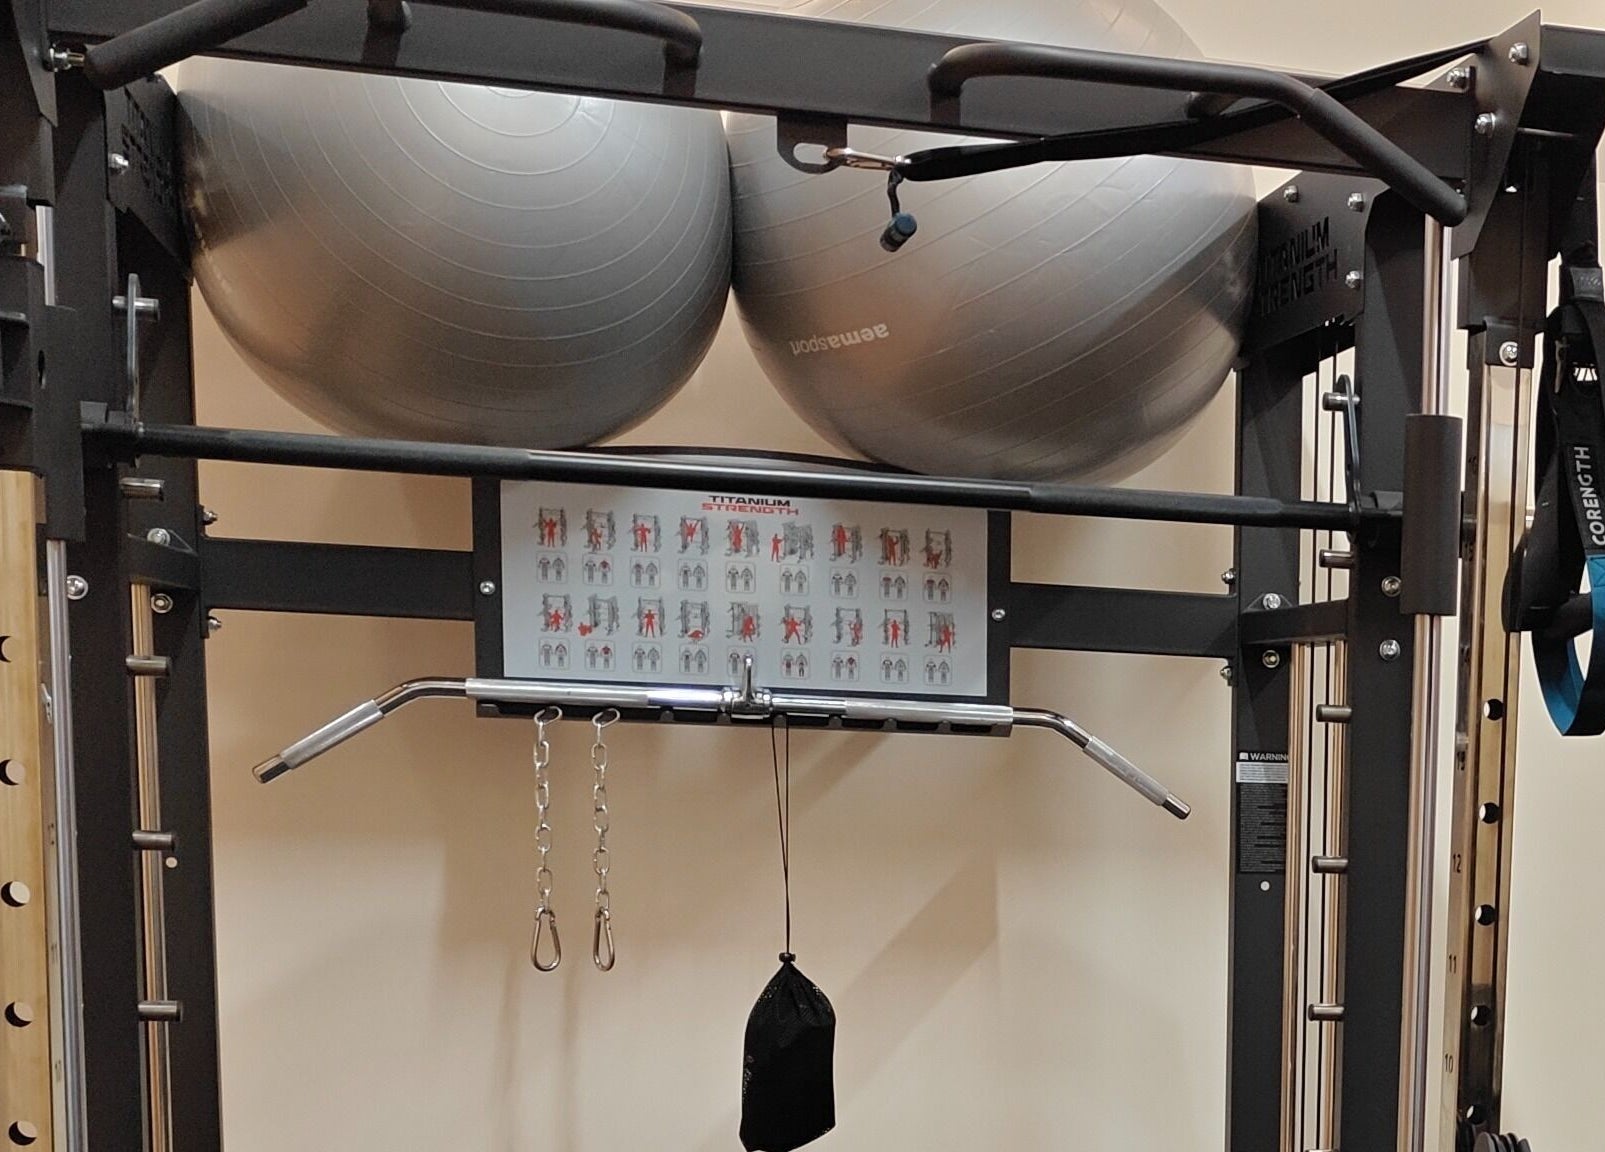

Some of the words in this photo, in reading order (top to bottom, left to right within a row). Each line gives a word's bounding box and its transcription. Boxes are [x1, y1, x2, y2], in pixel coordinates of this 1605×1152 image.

[708, 495, 791, 507] TITANIUM
[702, 502, 799, 516] STRENGTH
[1250, 752, 1289, 761] WARNIN
[1453, 853, 1461, 874] 12
[1444, 1053, 1454, 1074] 10
